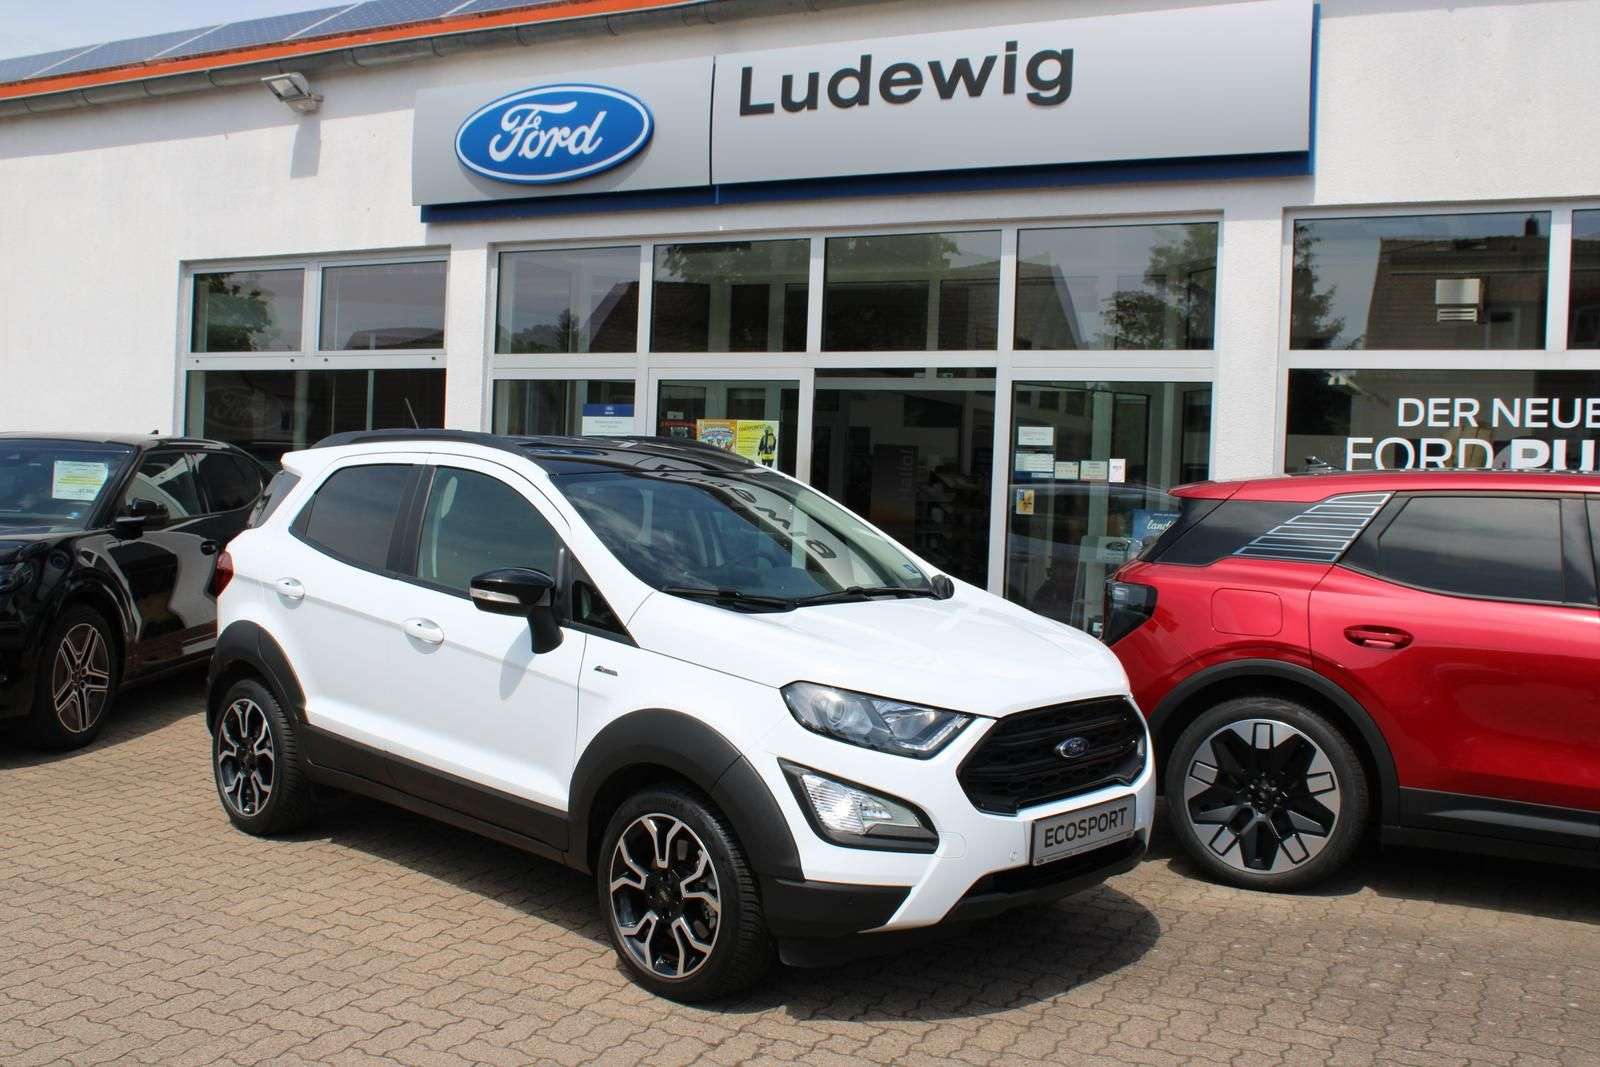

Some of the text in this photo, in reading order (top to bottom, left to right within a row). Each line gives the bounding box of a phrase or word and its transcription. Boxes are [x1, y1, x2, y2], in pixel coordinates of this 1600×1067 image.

[740, 41, 1074, 117] Ludewig
[488, 101, 608, 162] Ford
[1397, 398, 1600, 429] DER NEUE
[1346, 437, 1600, 471] FORD PU
[1044, 806, 1128, 849] ECOSPORT
